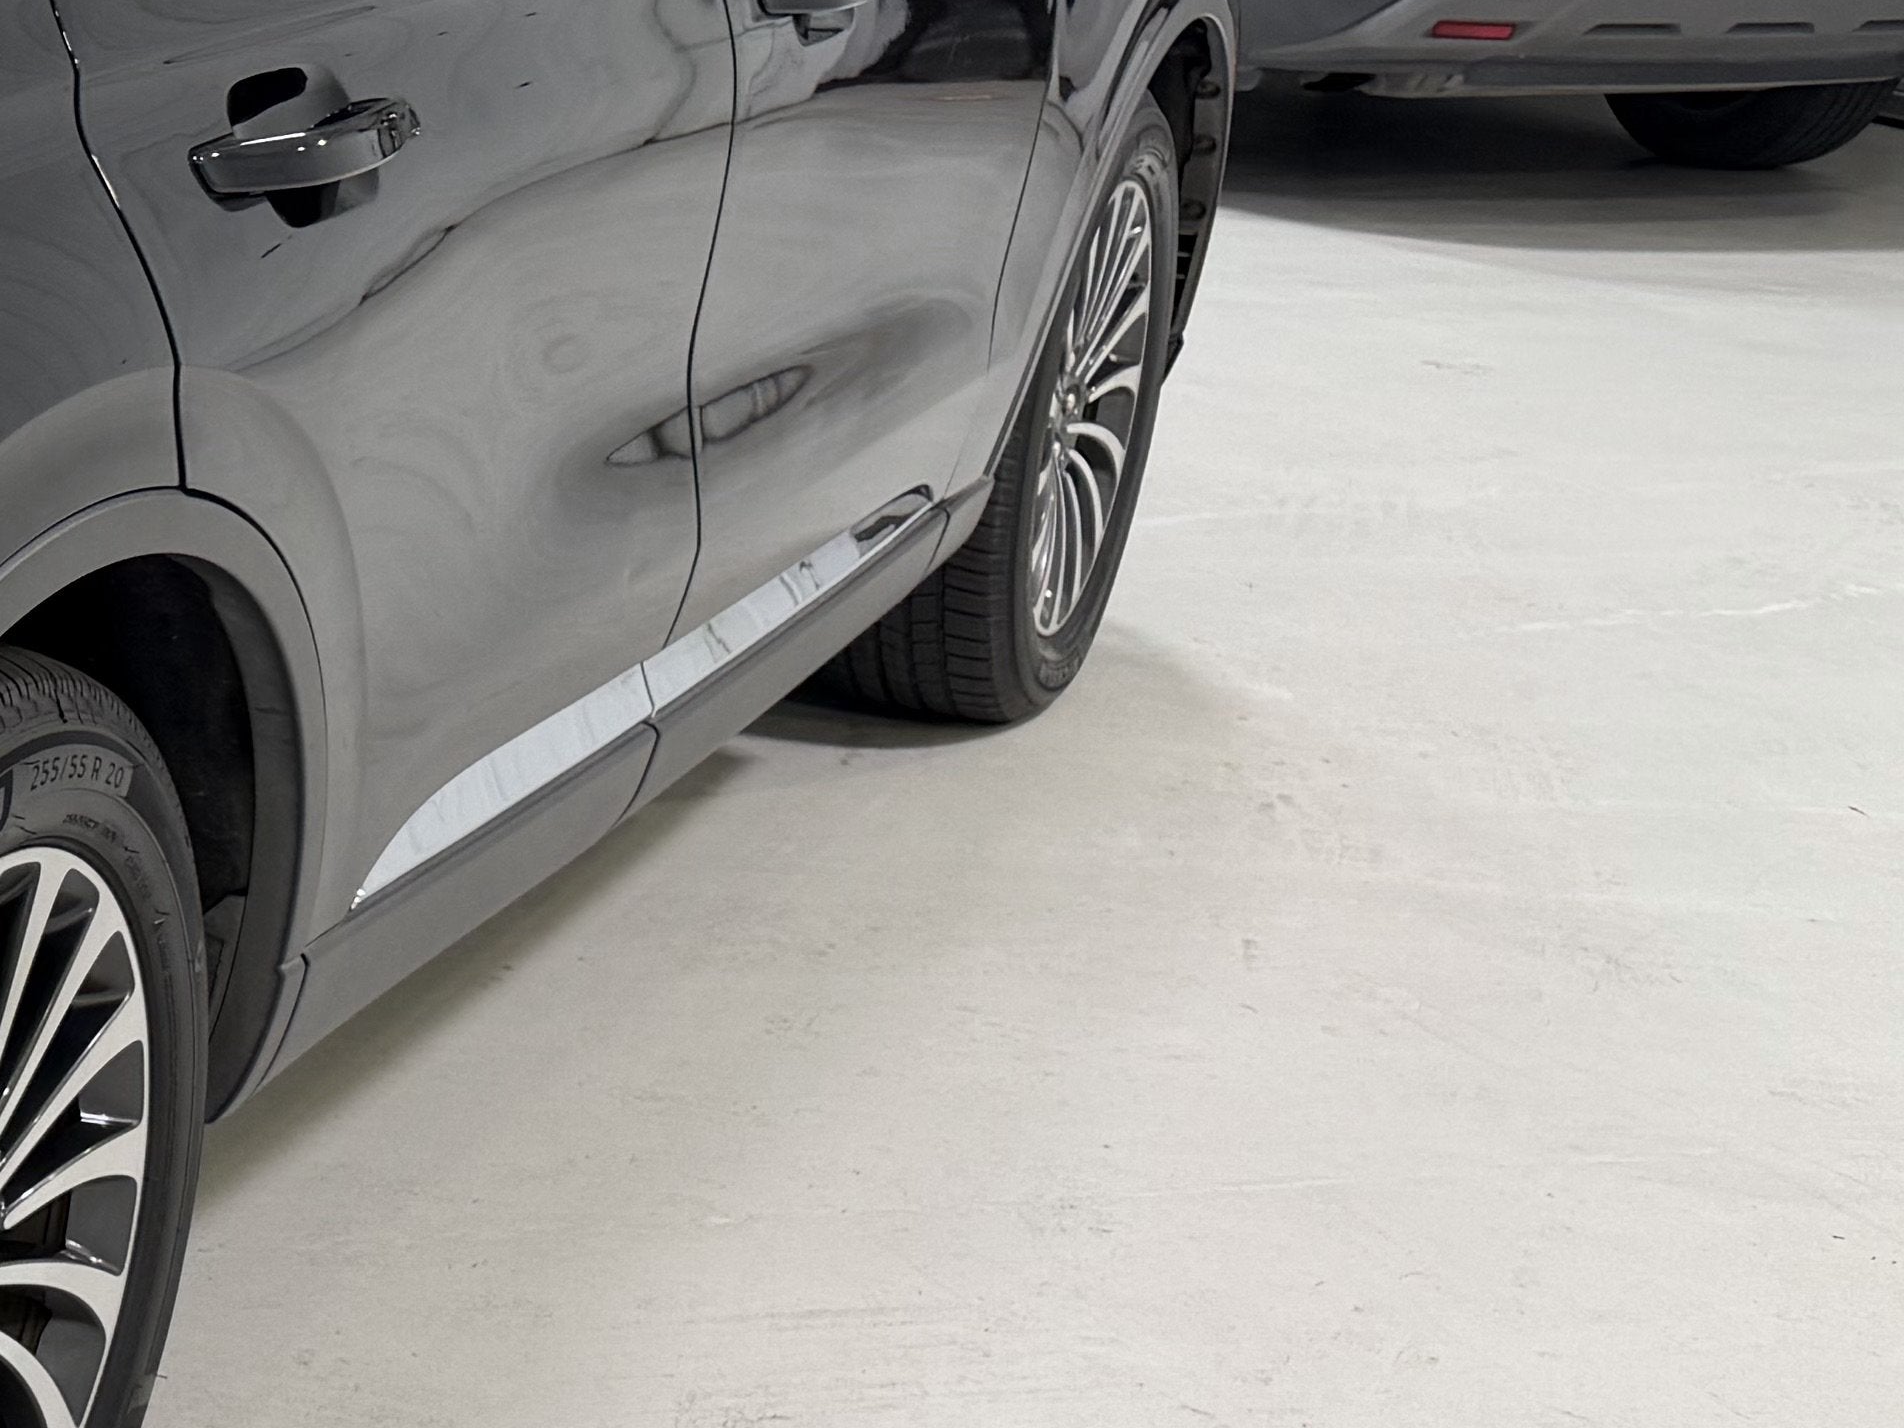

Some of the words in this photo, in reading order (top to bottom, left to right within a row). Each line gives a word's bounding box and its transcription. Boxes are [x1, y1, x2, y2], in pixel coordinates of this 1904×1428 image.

[30, 754, 88, 791] 255/55
[91, 756, 103, 781] R
[106, 763, 125, 789] 20
